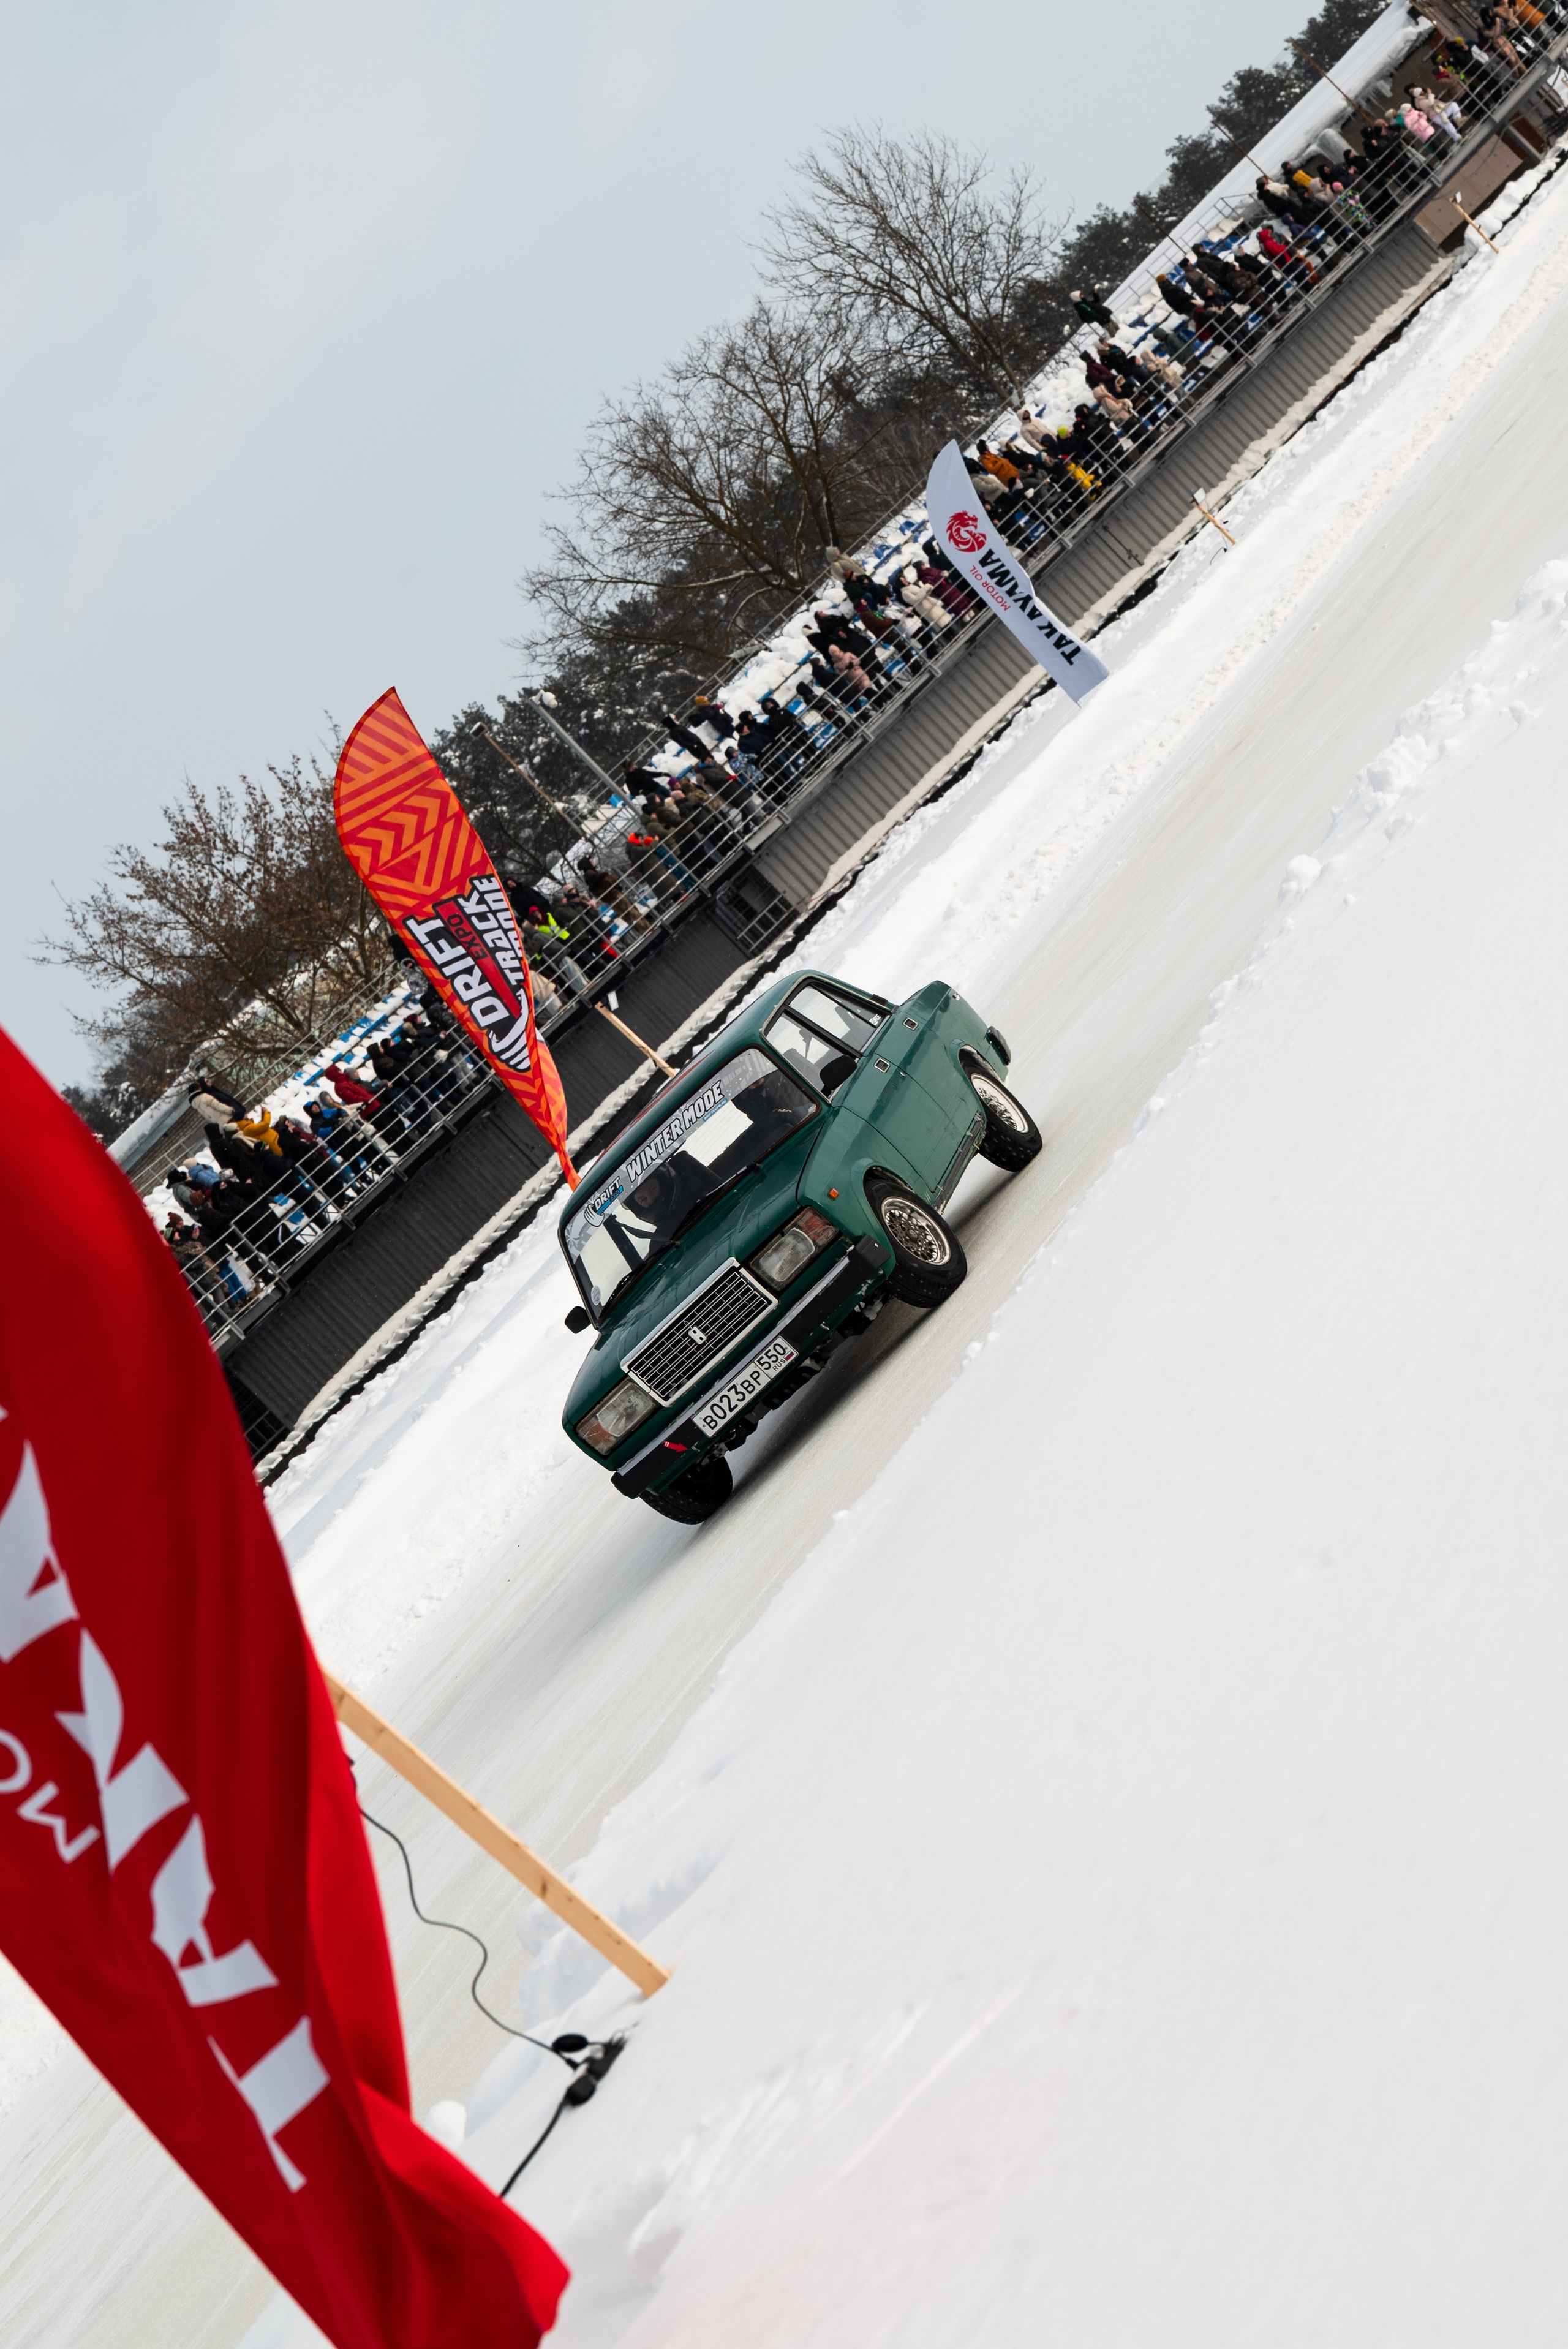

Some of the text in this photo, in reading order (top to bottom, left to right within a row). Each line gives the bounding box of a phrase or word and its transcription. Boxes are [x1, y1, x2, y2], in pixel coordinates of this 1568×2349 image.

[970, 565, 1010, 611] MOTOR OIL
[979, 548, 1082, 666] TAKAYAMA
[447, 913, 488, 960] EXPO
[457, 890, 524, 986] TRACK
[407, 916, 509, 1028] DRIFT
[625, 1079, 725, 1183] WINTER MODE
[594, 1176, 620, 1211] DRIFT
[609, 1189, 620, 1202] EXPO
[758, 1343, 786, 1370] 550
[772, 1358, 786, 1371] RUS
[0, 1408, 330, 2193] TAKA
